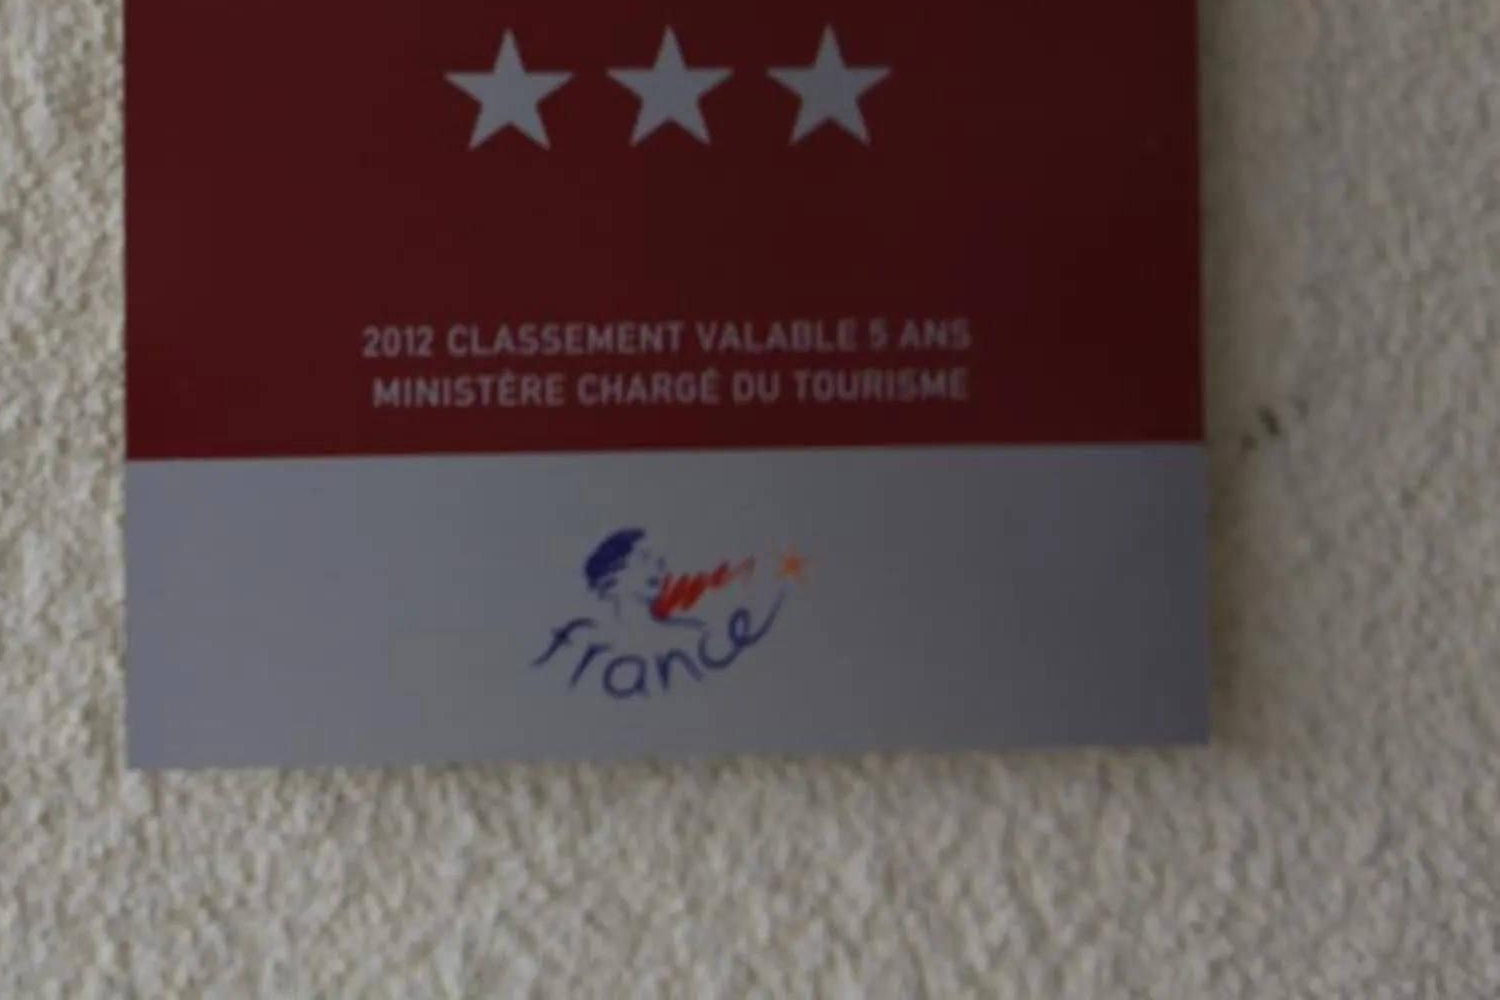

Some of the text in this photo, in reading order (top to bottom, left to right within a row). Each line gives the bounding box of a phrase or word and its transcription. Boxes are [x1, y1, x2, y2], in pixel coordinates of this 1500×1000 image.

[363, 316, 973, 358] 2012 CLASSEMENT VALABLE 5 ANS
[372, 366, 971, 409] MINISTÈRE CHARGÉ DU TOURISME
